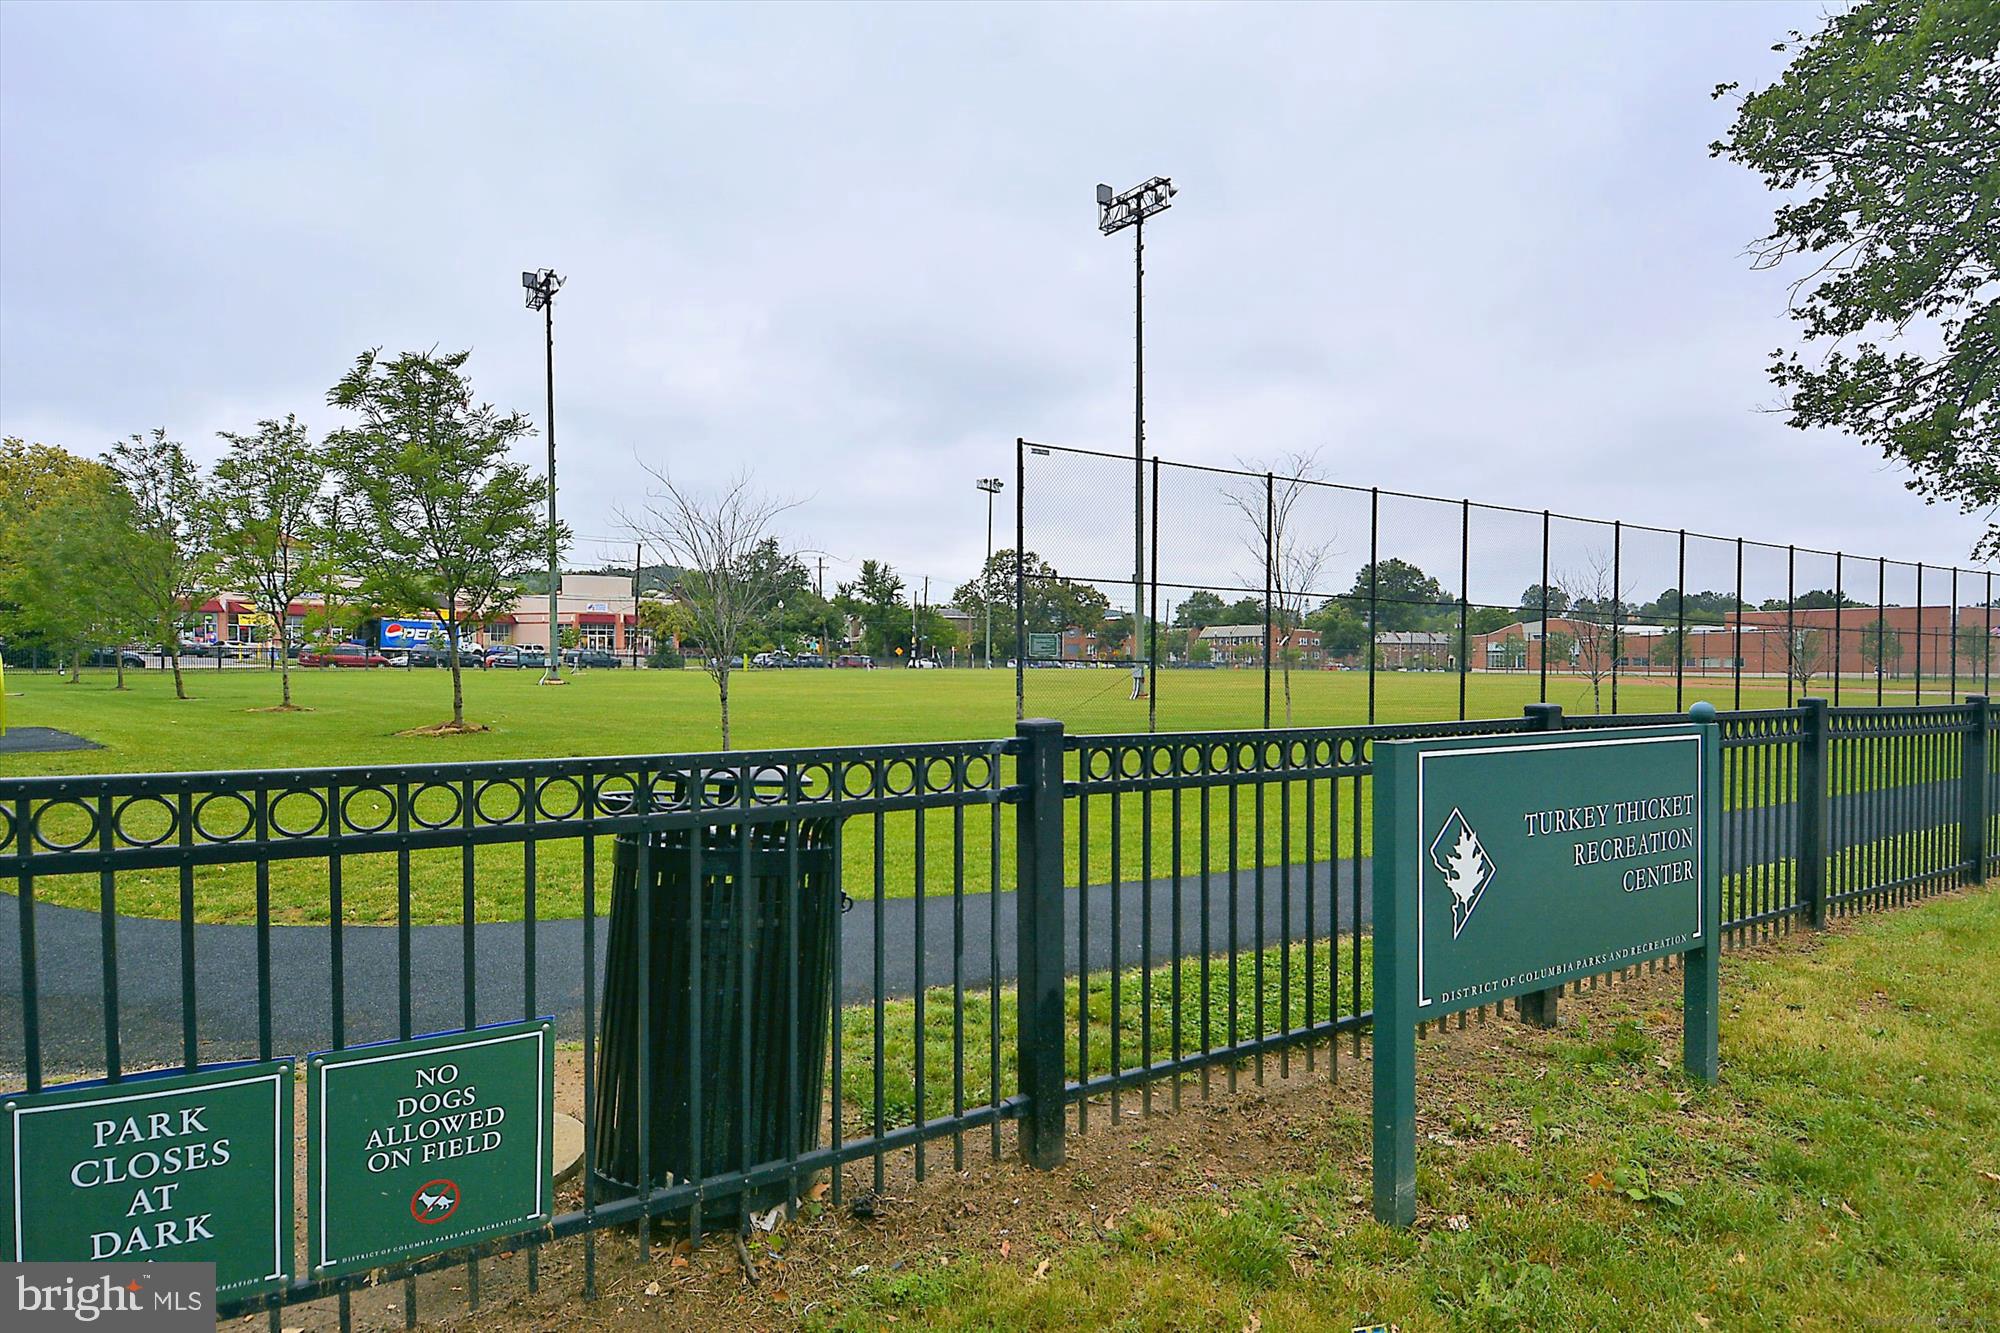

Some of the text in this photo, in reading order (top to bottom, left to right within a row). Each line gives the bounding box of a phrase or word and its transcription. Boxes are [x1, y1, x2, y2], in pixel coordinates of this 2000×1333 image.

[1524, 794, 1694, 836] TURKEY THICKET
[1574, 827, 1693, 866] RECREATION
[1622, 859, 1694, 892] CENTER
[1442, 933, 1688, 1003] DISTRICT OF COLUMBIA PARKS AND RECREATION
[415, 1064, 459, 1089] NO
[397, 1086, 476, 1119] DOGS
[93, 1106, 209, 1149] PARK
[364, 1106, 506, 1151] ALLOWED
[69, 1139, 231, 1188] CLOSES
[367, 1131, 502, 1174] ON FIELD
[126, 1183, 179, 1217] AT
[90, 1213, 215, 1261] DARK
[215, 1278, 259, 1292] CREATION
